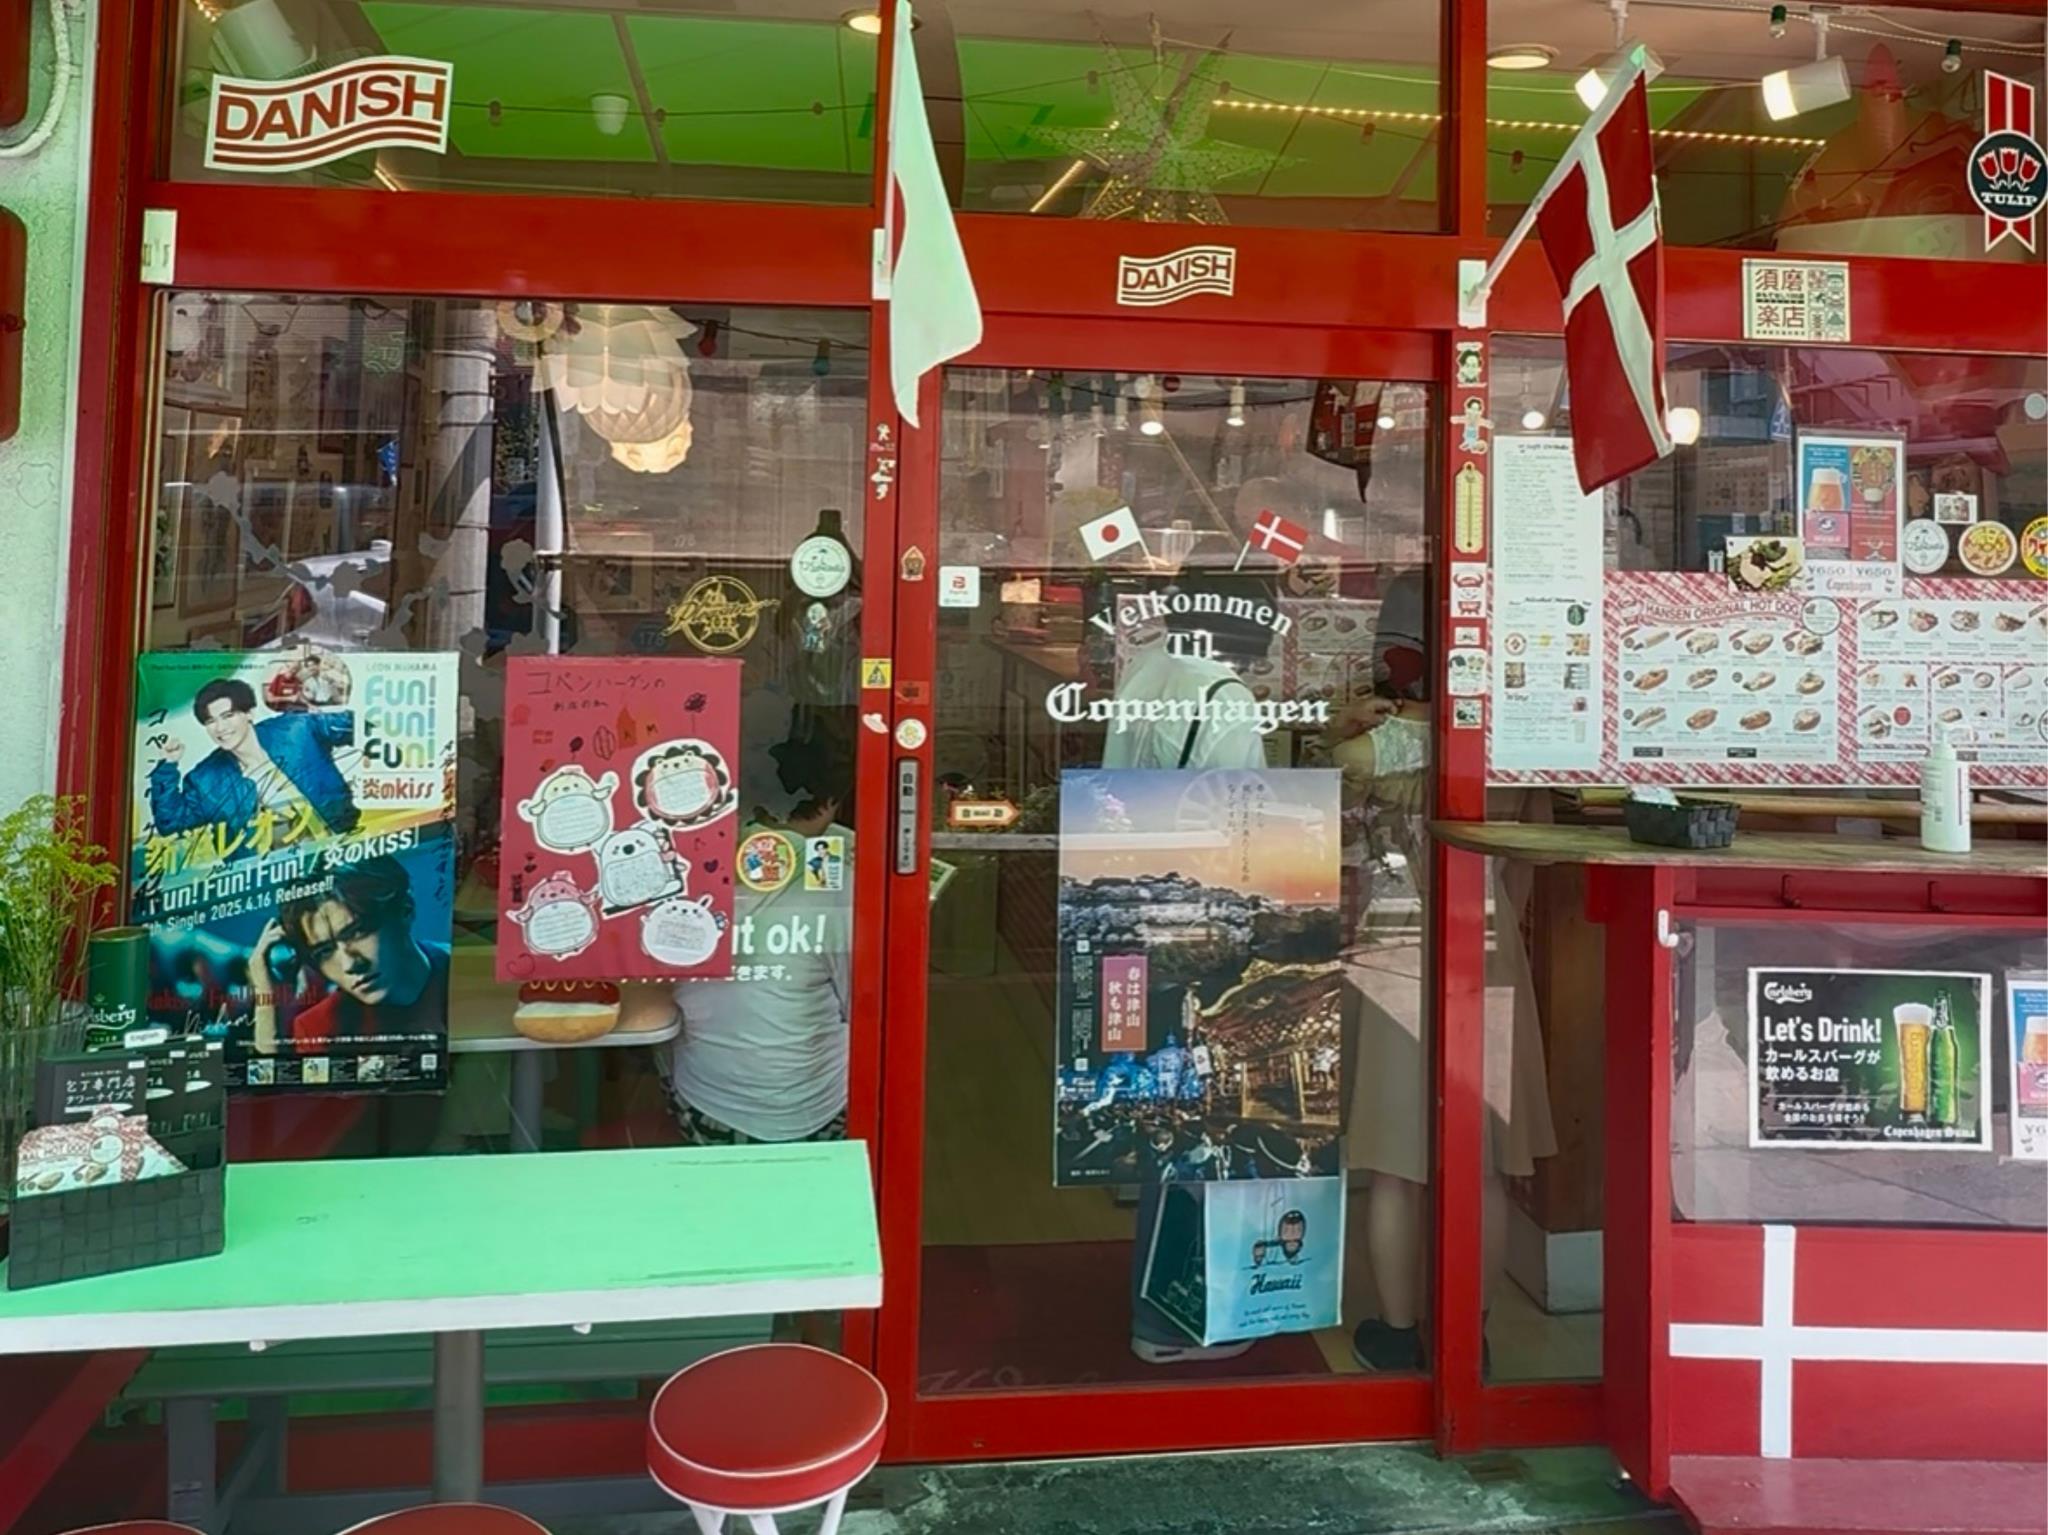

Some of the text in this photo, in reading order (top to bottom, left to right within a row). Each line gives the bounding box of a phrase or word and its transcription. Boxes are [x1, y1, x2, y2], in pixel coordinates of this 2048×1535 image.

[215, 73, 447, 141] DANISH
[1980, 191, 2038, 207] TULIP
[1121, 254, 1232, 291] DANISH
[1755, 268, 1805, 291] 須磨
[1756, 305, 1805, 329] 楽店
[1088, 589, 1293, 637] Velkommen
[1646, 600, 1799, 620] HANSEN ORIGINAL HOT DOG
[1166, 629, 1220, 660] Til
[1045, 682, 1331, 735] Copenhagen
[363, 777, 435, 801] 炎のkiss
[203, 861, 252, 902] Fun!
[256, 849, 306, 888] Fun!
[166, 909, 207, 934] Single
[211, 893, 272, 922] 2025.4.16
[275, 875, 335, 905] Release!!
[766, 913, 827, 955] ok!
[1126, 966, 1142, 1028] 春は津山
[1763, 982, 1813, 1004] Carlsberg
[1107, 981, 1122, 1041] 秋も津山
[1764, 1017, 1882, 1043] Let's Drink!
[1764, 1049, 1882, 1065] カールスバーグが
[66, 1075, 136, 1093] 包丁専門店
[1765, 1066, 1840, 1082] 飲めるお店
[1883, 1125, 1943, 1139] Copenhagen
[1249, 1273, 1303, 1296] Hawaii
